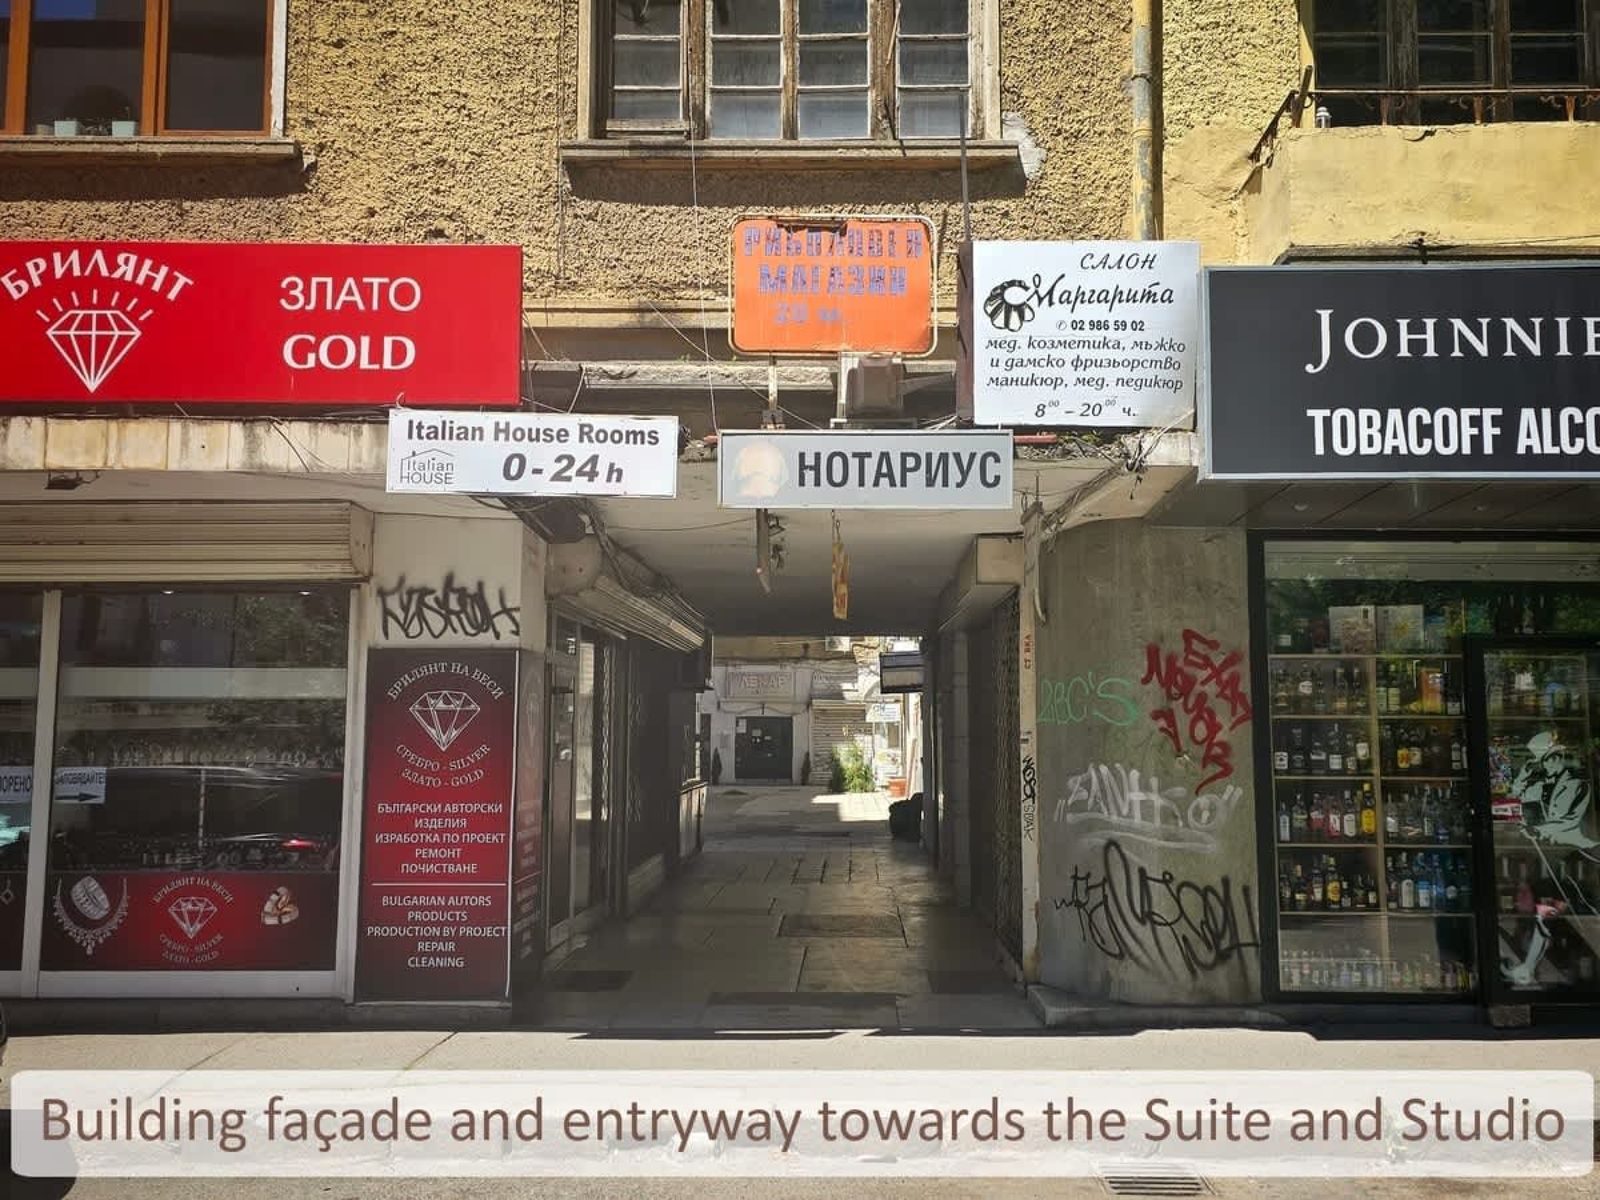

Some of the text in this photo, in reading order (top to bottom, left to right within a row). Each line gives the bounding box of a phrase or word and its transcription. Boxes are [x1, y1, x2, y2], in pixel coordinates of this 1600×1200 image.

[1080, 253, 1158, 270] САЛОН
[0, 248, 194, 301] БРИЛЯНТ
[280, 276, 421, 312] ЗЛАТО
[1025, 273, 1174, 314] Маргарита
[1071, 319, 1145, 331] 02 986 59 02
[282, 334, 416, 370] GOLD
[985, 335, 1185, 353] мед. козметика, мъжко
[989, 353, 1181, 371] и дамско фризьорство
[987, 374, 1183, 393] маникюр, мед. педикюр
[407, 419, 659, 445] Italian House Rooms
[1307, 408, 1503, 455] TOBACOFF
[407, 457, 454, 472] Italian
[605, 462, 623, 483] h
[799, 451, 1001, 489] НОТАРИУС
[400, 471, 454, 485] HOUSE
[387, 662, 504, 700] БРИЛЯНТ НА ВЕСИ
[396, 744, 440, 770] СРЕБРО
[449, 744, 490, 769] SILVER
[401, 768, 442, 787] ЗЛАТО
[451, 768, 484, 787] GOLD
[377, 804, 503, 814] БЪЛГАРСКИ АВТОРСКИ
[415, 819, 467, 830] ИЗДЕЛИЯ
[375, 833, 506, 843] ИЗРАБОТКА ПО ПРОЕКТ
[415, 848, 462, 858] РЕМОНТ
[401, 863, 477, 874] ПОЧИСТВАНЕ
[382, 895, 492, 906] BULGARIAN AUTORS
[407, 911, 468, 921] PRODUCTS
[367, 926, 506, 937] PRODUCTION BY PROJECT
[417, 942, 456, 952] REPAIR
[407, 957, 465, 968] CLEANING
